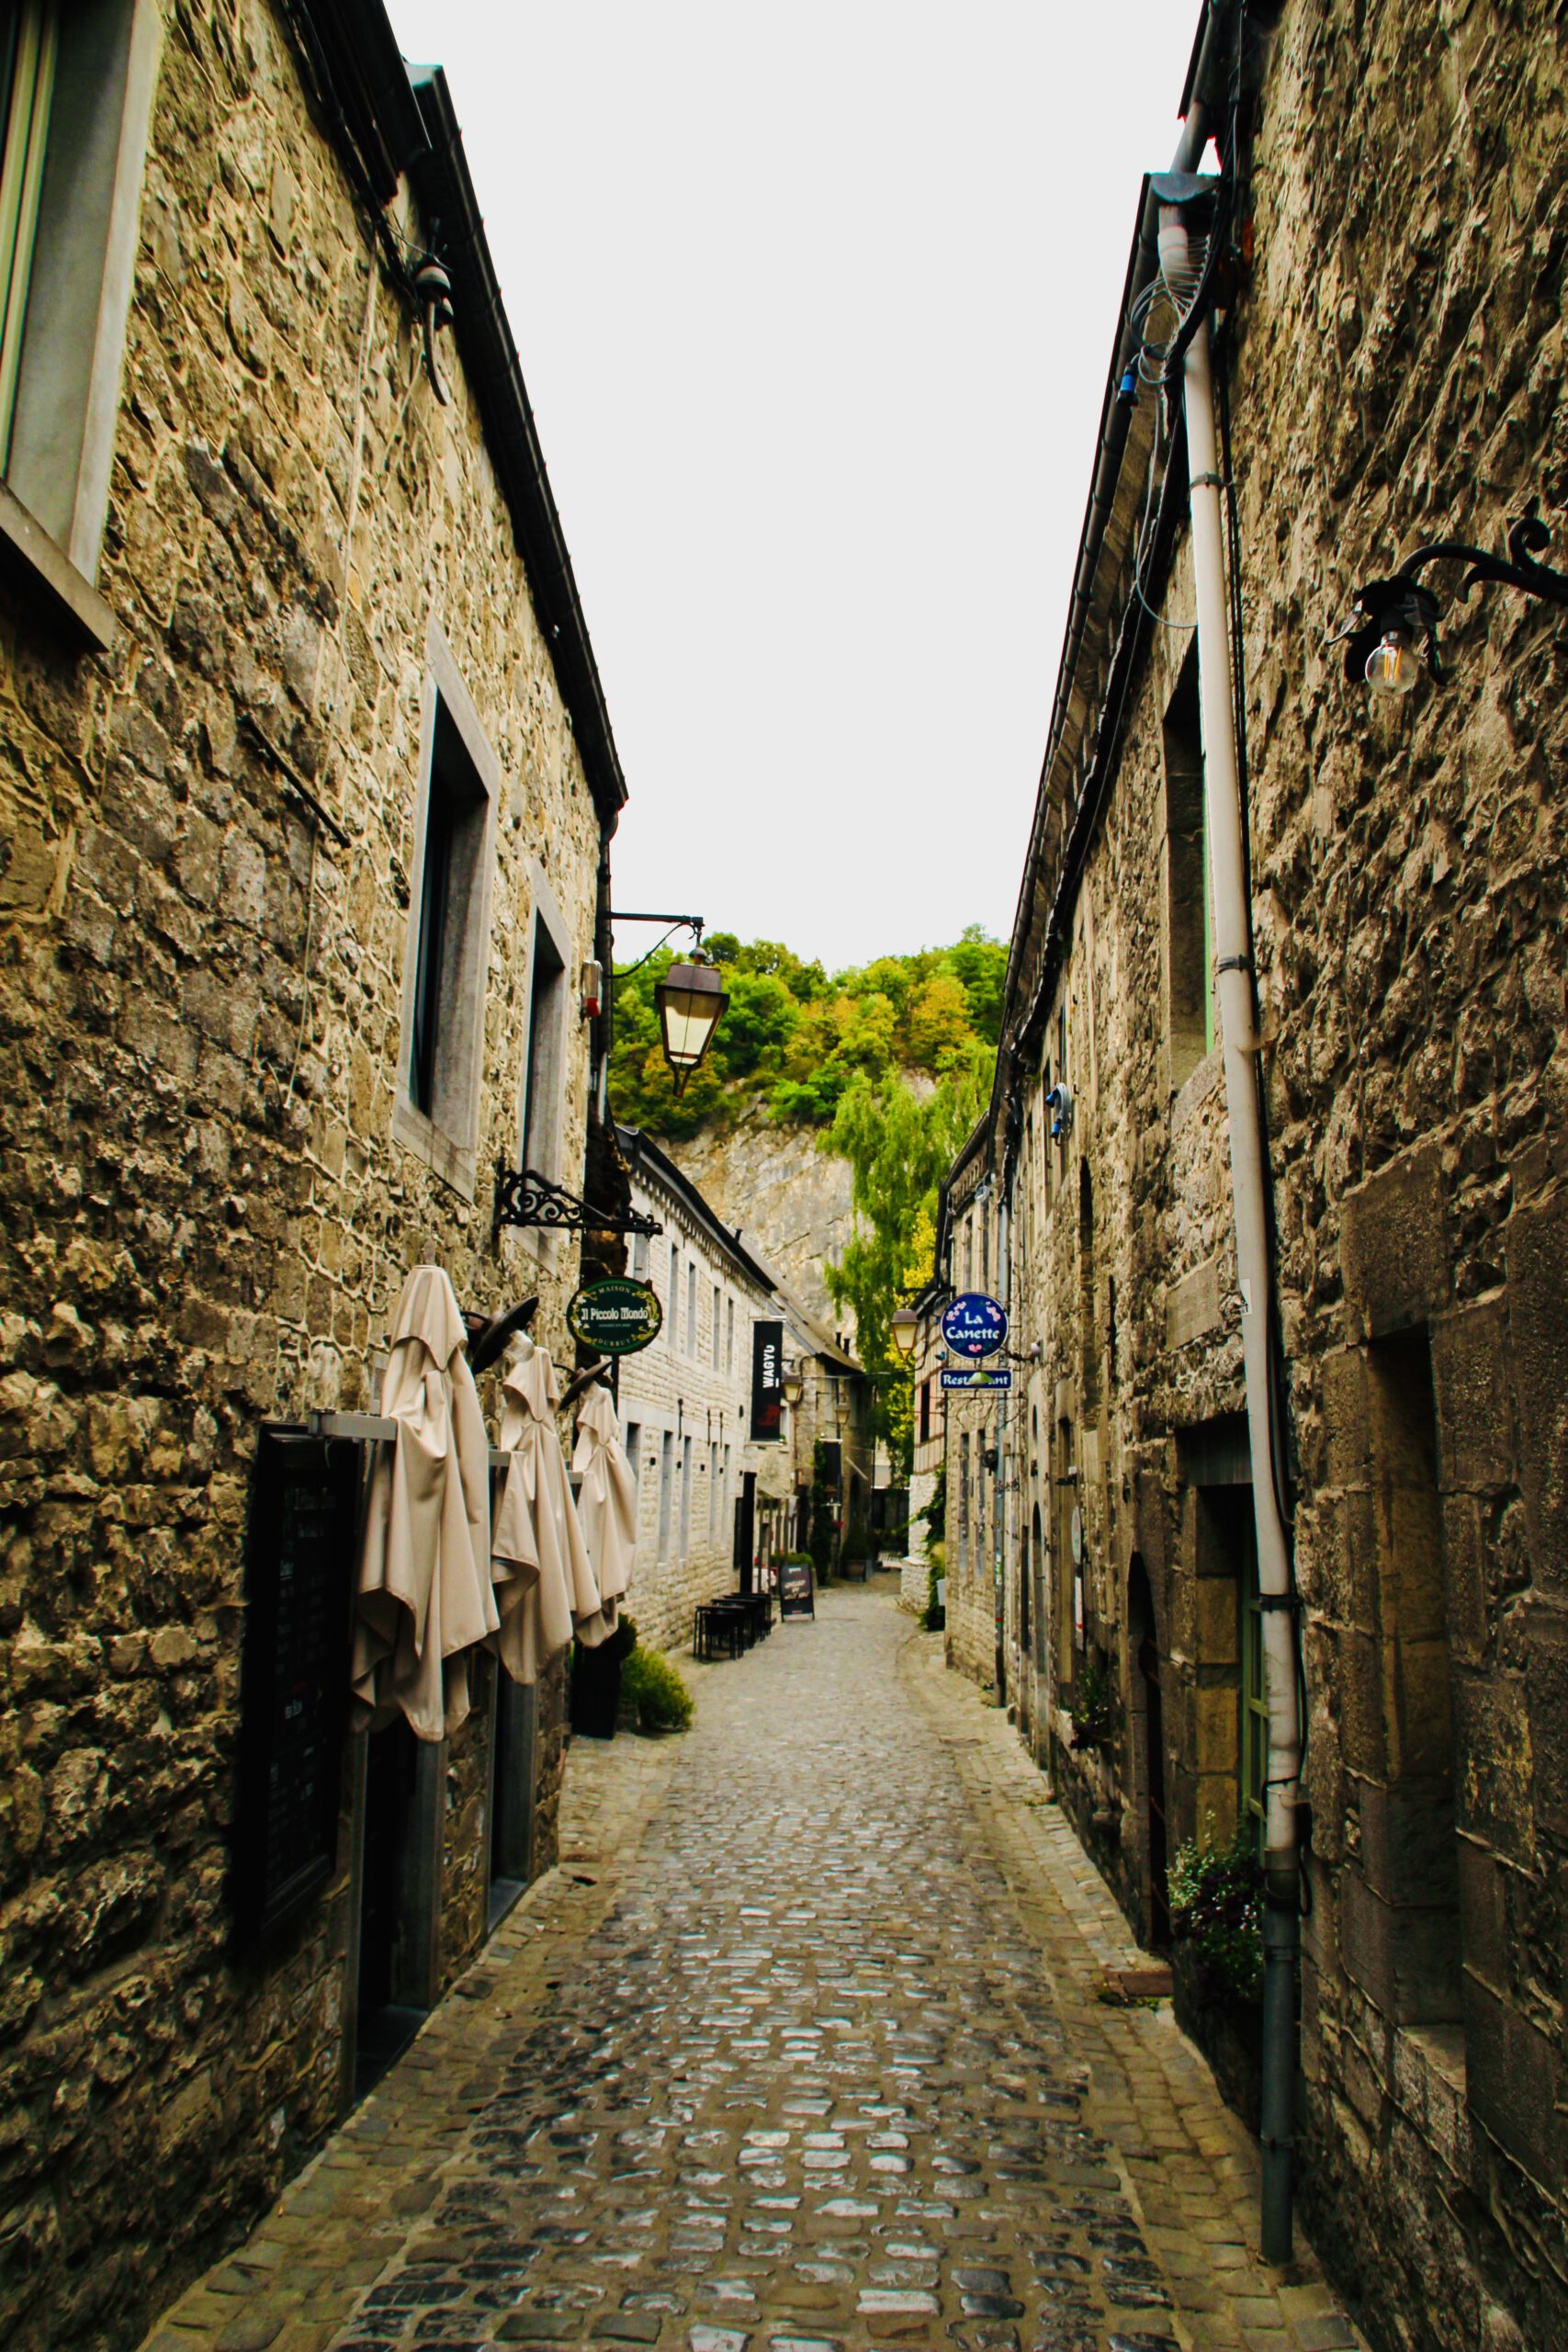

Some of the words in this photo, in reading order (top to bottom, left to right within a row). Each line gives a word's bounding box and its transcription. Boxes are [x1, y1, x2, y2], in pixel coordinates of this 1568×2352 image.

[598, 1285, 631, 1294] MAISON
[591, 1307, 618, 1320] Piccolo
[620, 1307, 649, 1319] Mondo
[964, 1311, 983, 1324] La
[946, 1327, 1000, 1339] Canette
[763, 1344, 775, 1388] WAGYU
[942, 1374, 1009, 1385] Restnt
